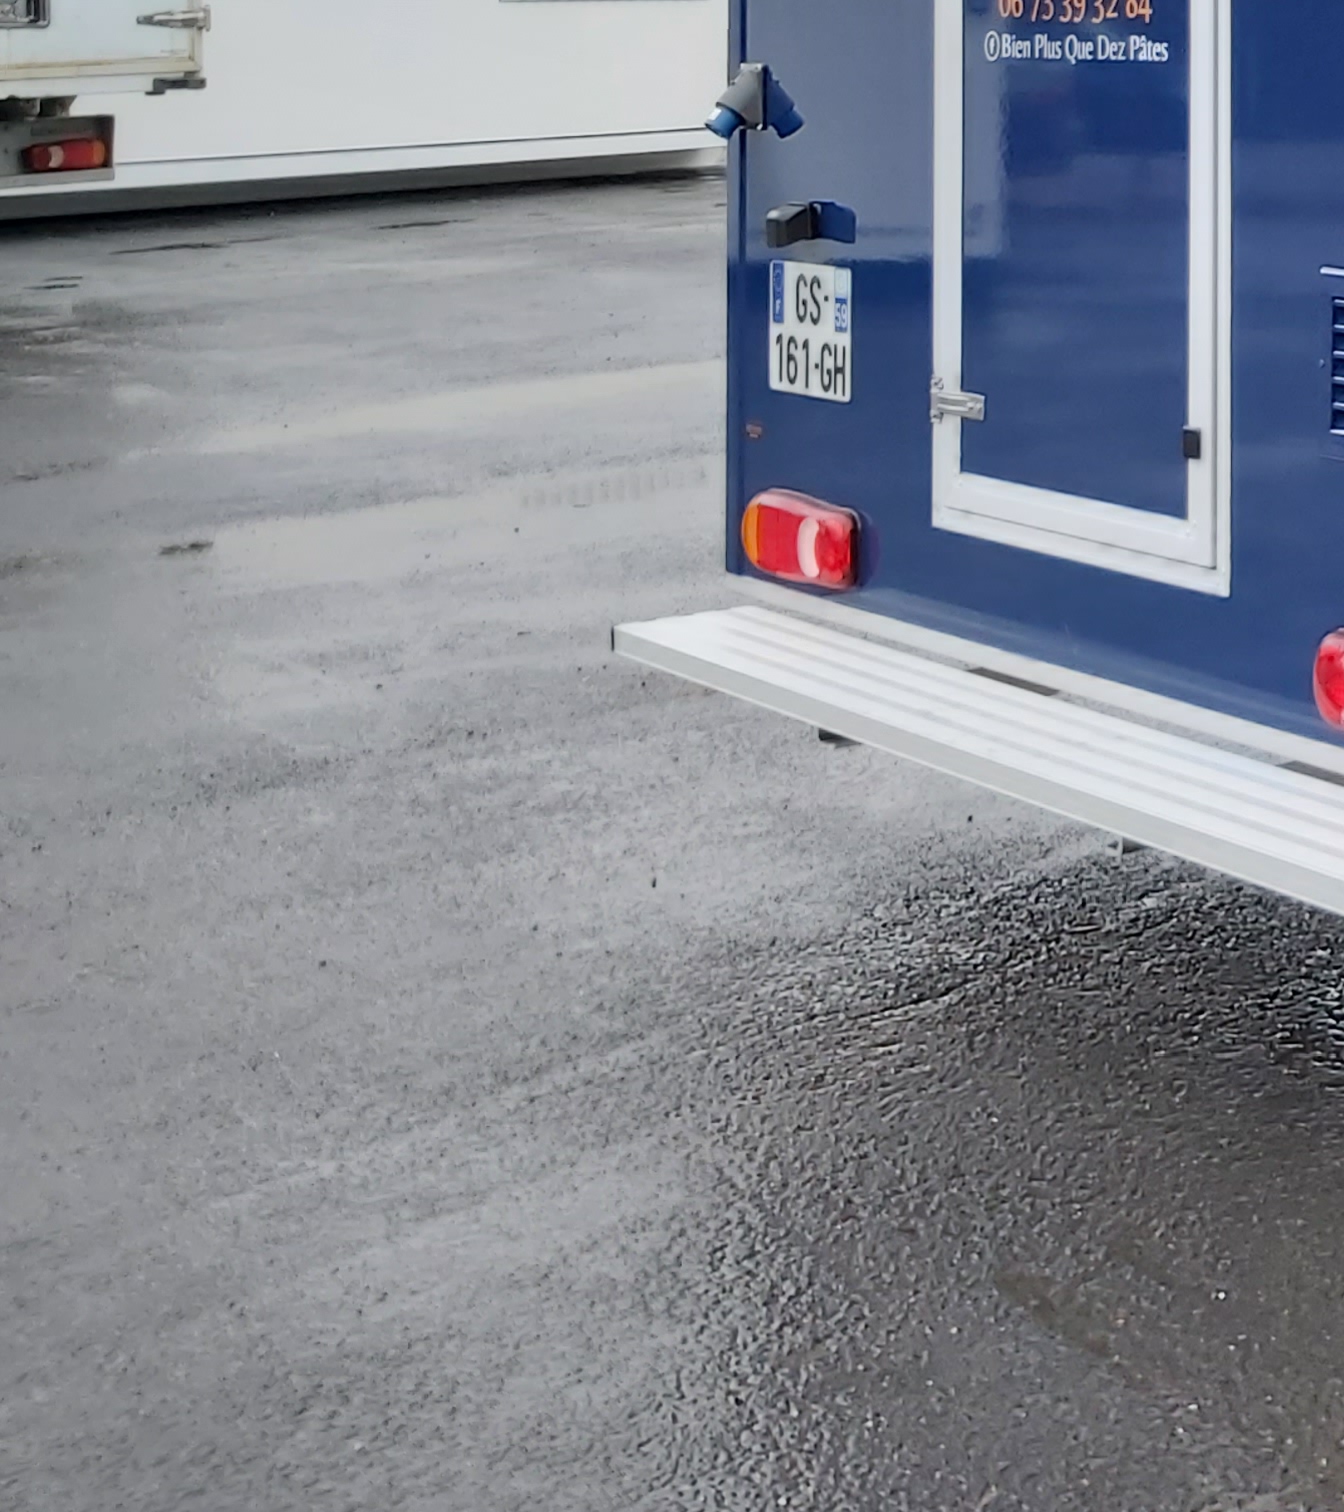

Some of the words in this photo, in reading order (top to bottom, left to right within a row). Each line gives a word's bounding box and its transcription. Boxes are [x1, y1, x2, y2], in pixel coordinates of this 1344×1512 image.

[1002, 33, 1031, 59] Bien
[1034, 33, 1062, 61] Plus
[1064, 35, 1094, 64] Que
[1097, 35, 1126, 61] Dez
[1130, 35, 1169, 62] Pâtes
[835, 302, 848, 328] 59
[775, 332, 846, 397] 161-GH
